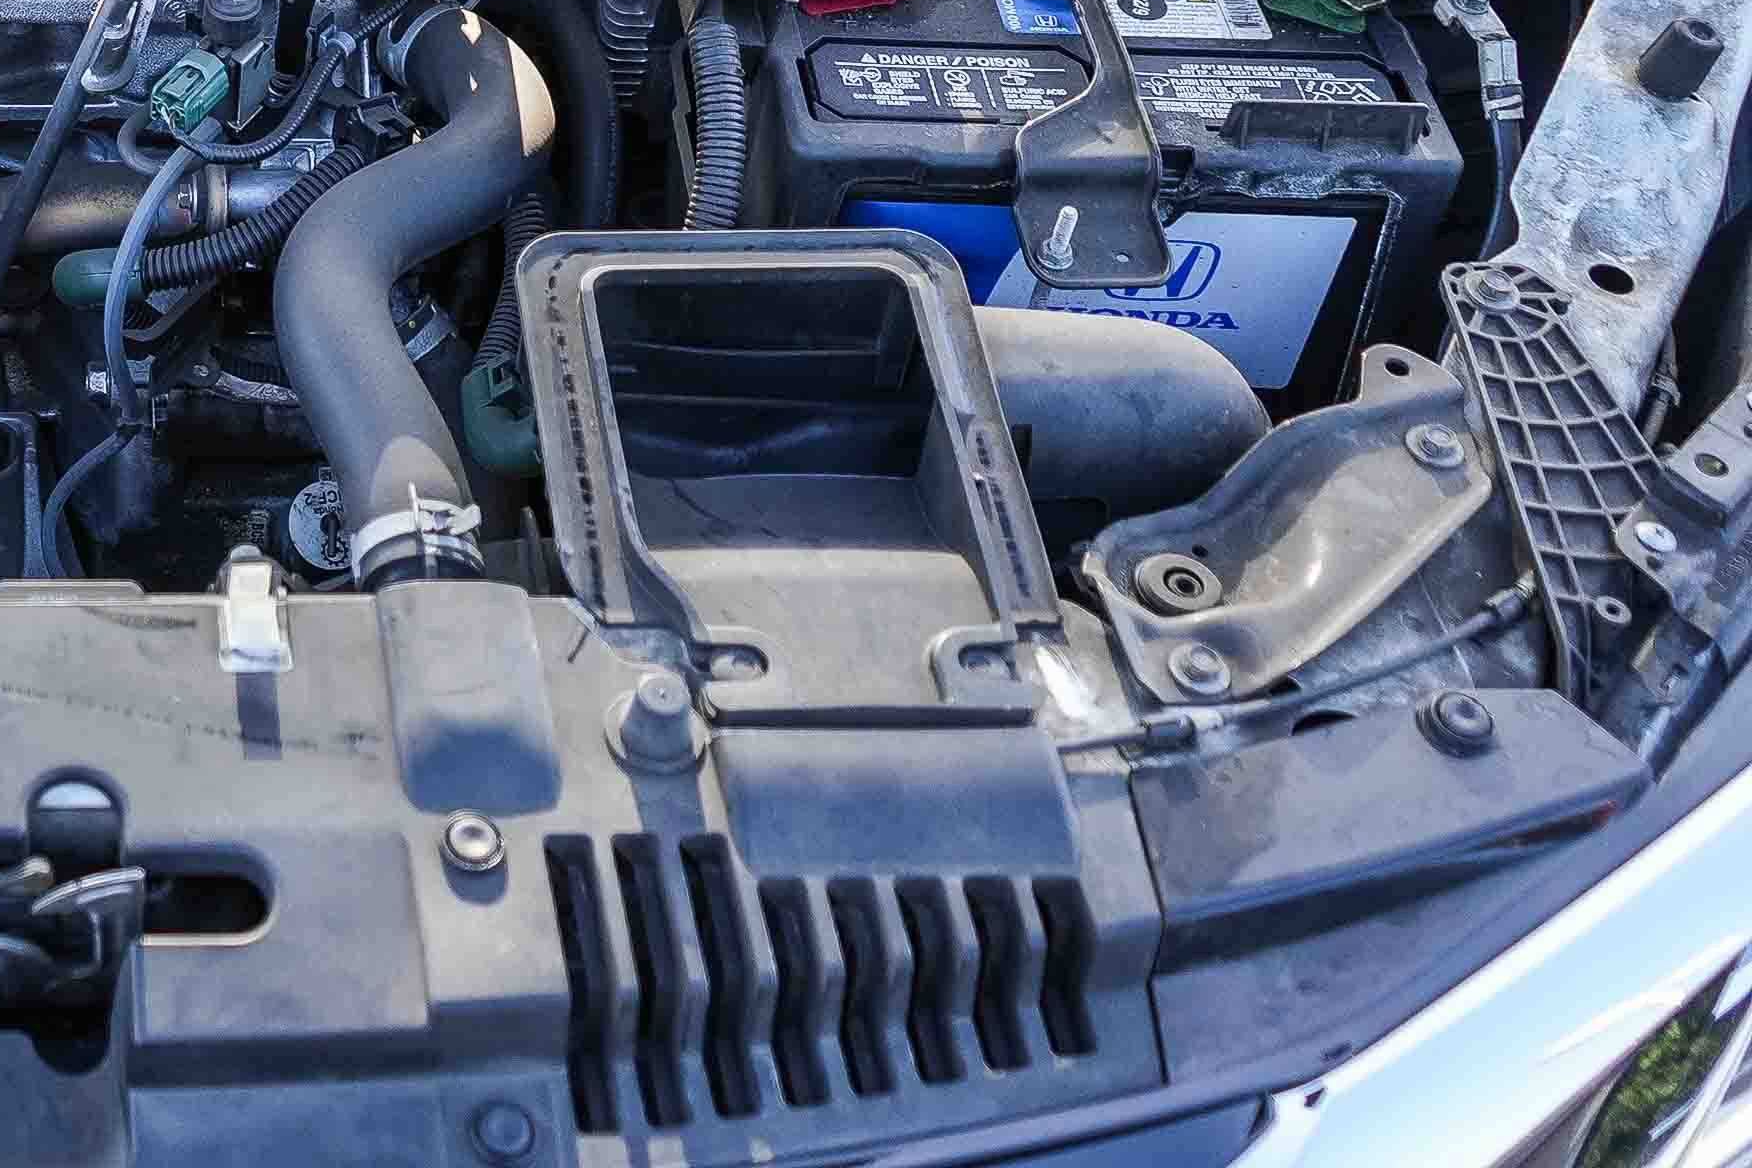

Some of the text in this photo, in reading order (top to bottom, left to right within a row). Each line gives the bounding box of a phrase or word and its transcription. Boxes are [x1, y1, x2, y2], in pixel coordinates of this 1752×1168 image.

[878, 54, 948, 66] DANGER
[964, 56, 1030, 68] POISON
[1223, 80, 1282, 88] IMMEDIATELY
[1000, 86, 1044, 94] SULFURIC
[1047, 306, 1240, 330] NDA
